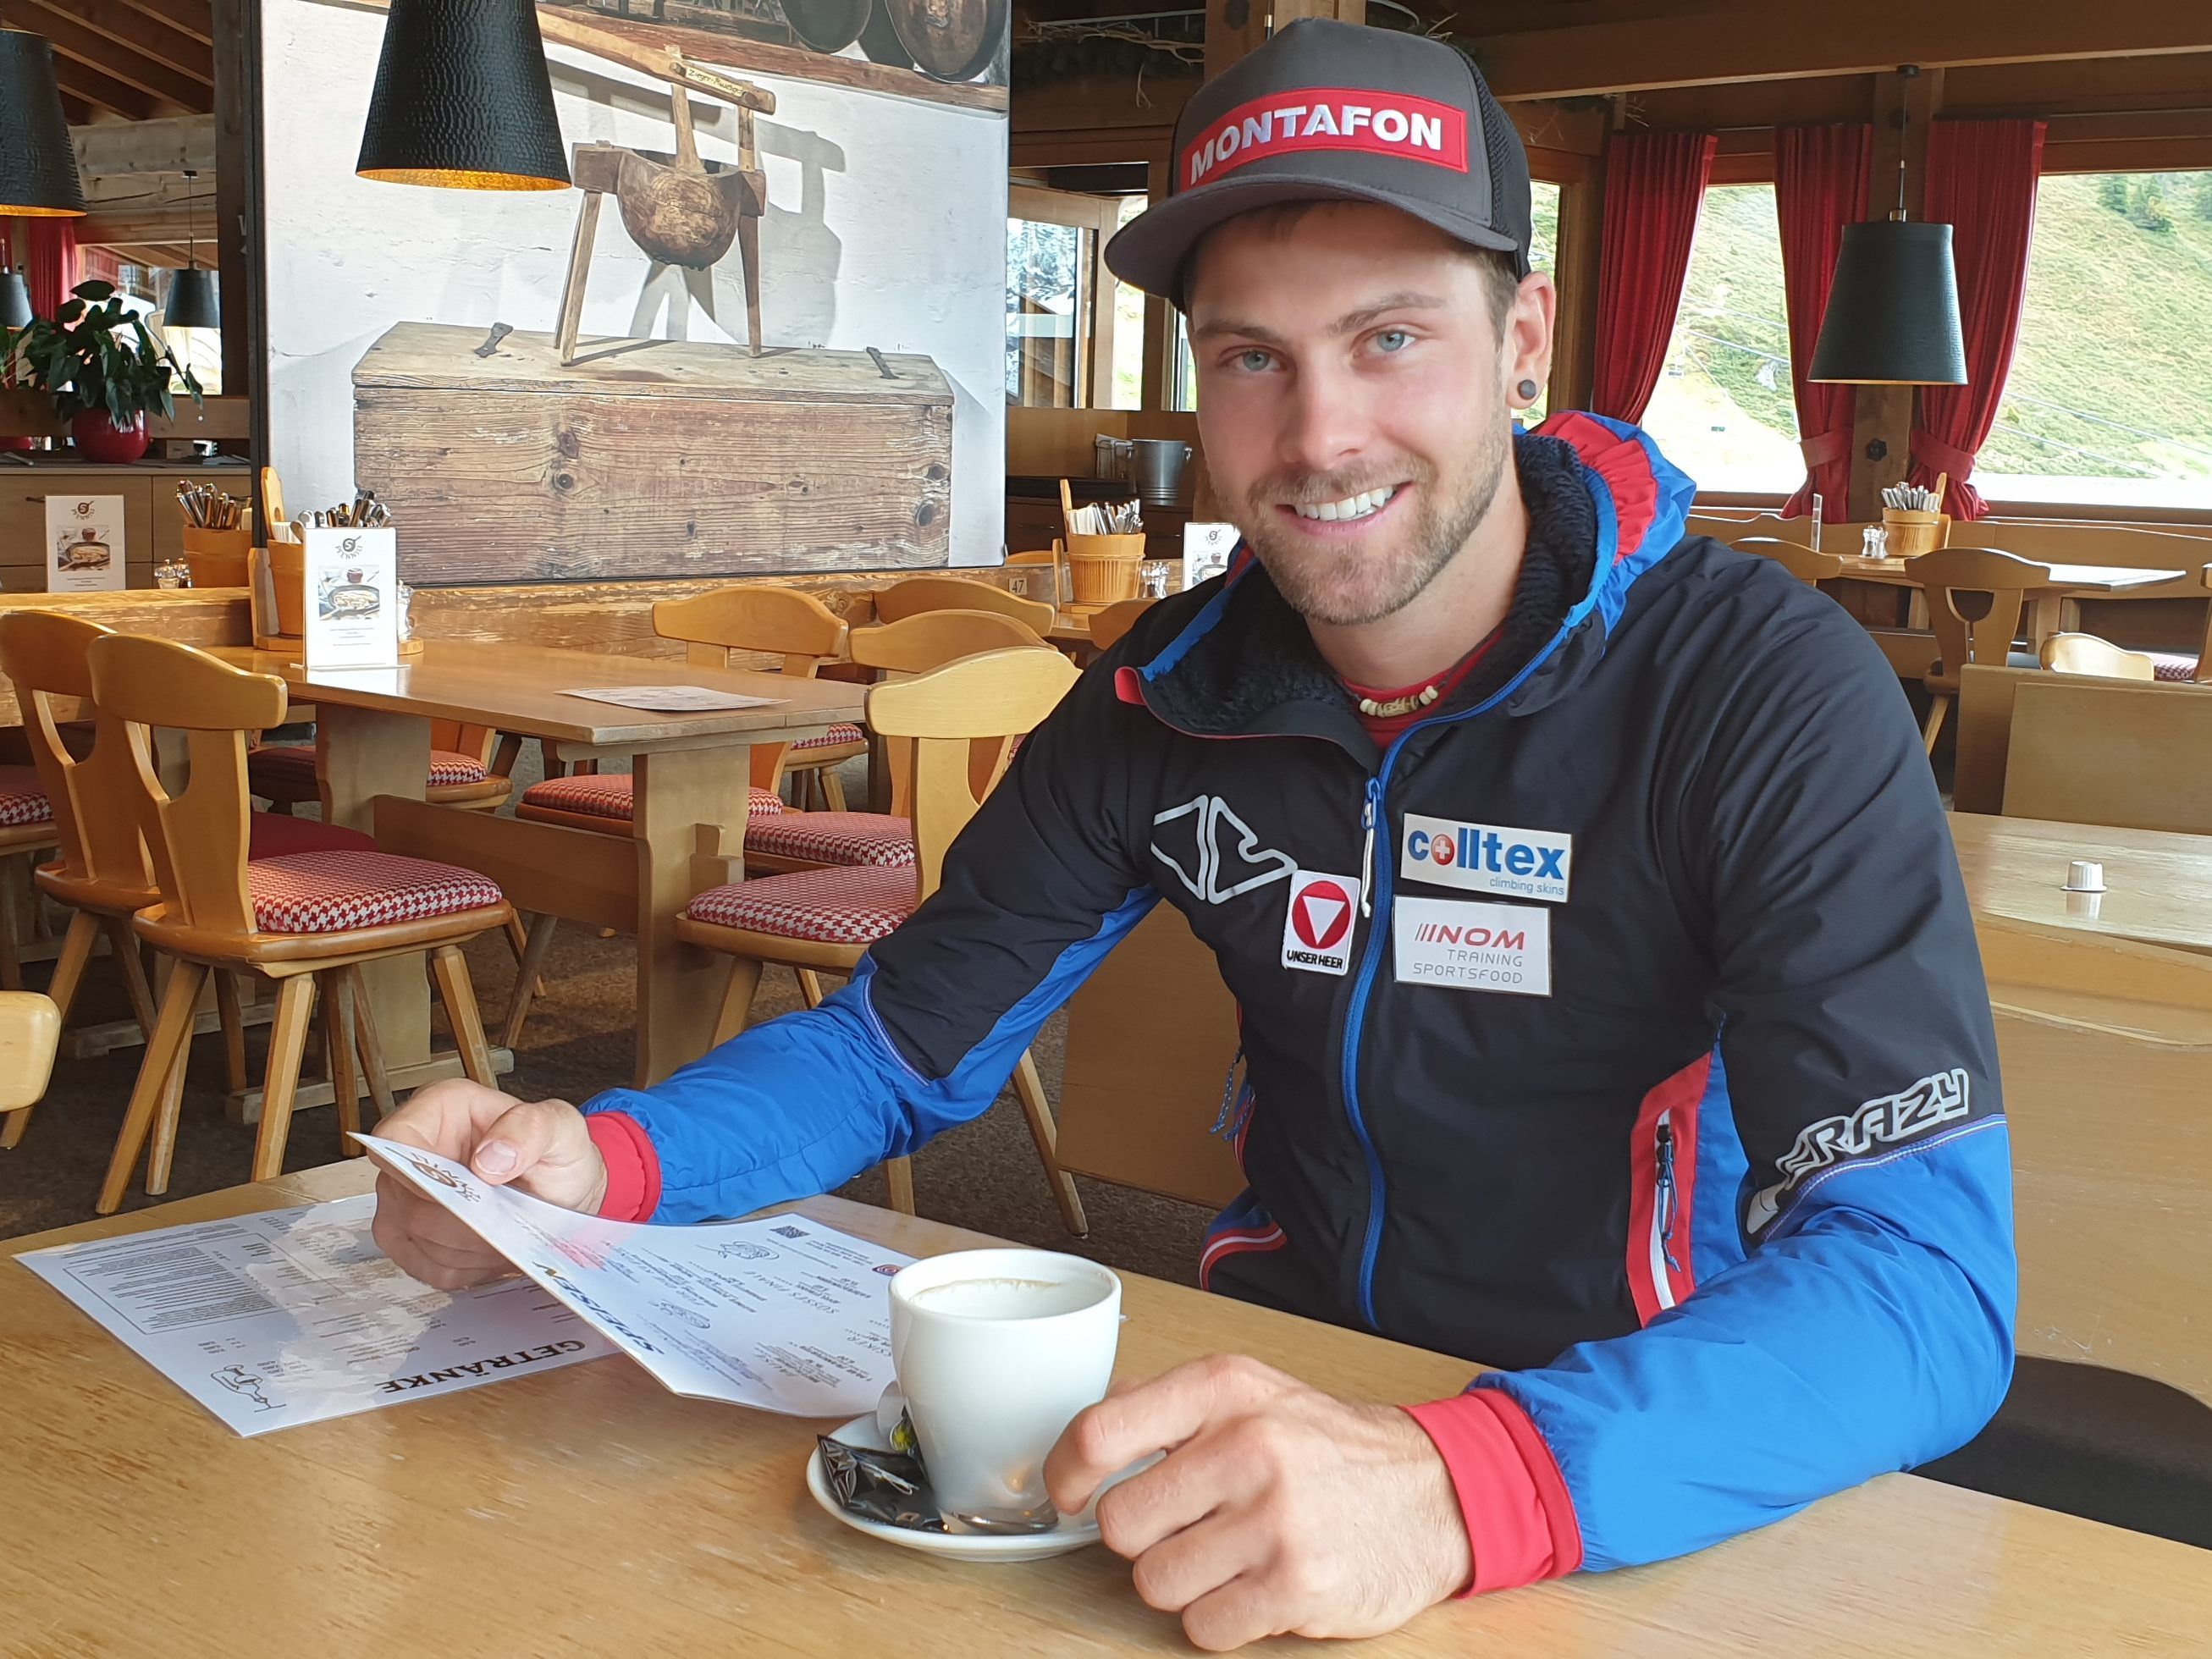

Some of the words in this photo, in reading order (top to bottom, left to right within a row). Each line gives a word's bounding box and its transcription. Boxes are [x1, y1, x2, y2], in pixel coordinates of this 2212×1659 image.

[1190, 104, 1442, 186] MONTAFON
[1011, 579, 1025, 594] 47
[1408, 827, 1566, 880] colltex
[1489, 877, 1534, 894] climbing
[1536, 883, 1565, 896] skins
[1286, 950, 1318, 965] UNSER
[1318, 956, 1343, 969] HEER
[1447, 949, 1523, 967] TRAINING
[1412, 962, 1523, 984] SPORTSFOOD
[532, 1261, 665, 1355] SPEISEN
[374, 1339, 586, 1394] GETRÄNKE
